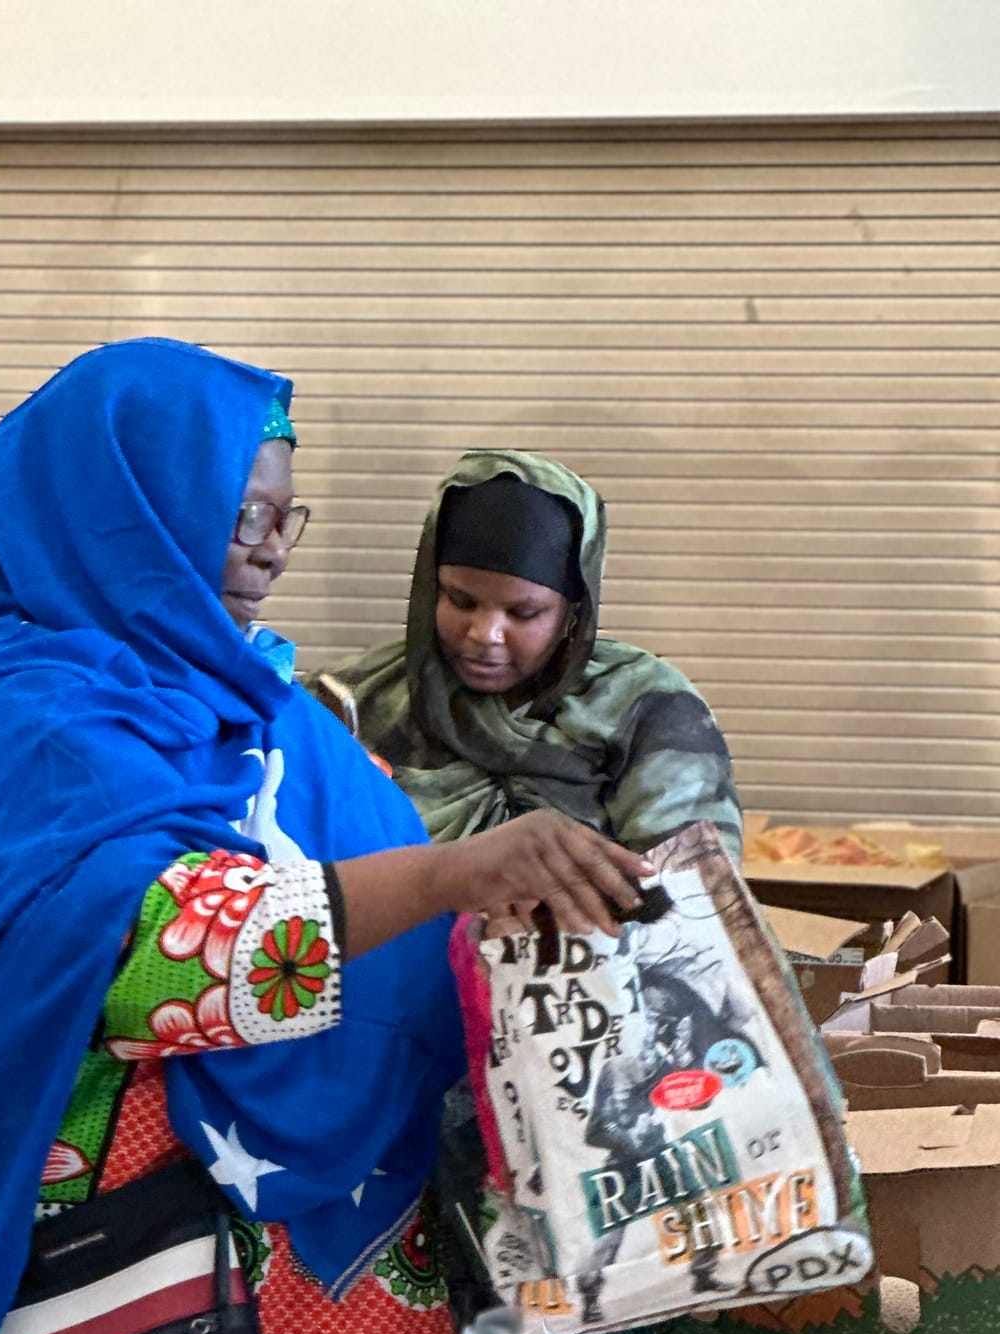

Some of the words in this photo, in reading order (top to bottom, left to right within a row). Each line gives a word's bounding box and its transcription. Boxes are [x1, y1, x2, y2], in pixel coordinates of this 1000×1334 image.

[589, 1127, 733, 1230] RAIN
[746, 1128, 782, 1160] or
[765, 1242, 861, 1290] PDX
